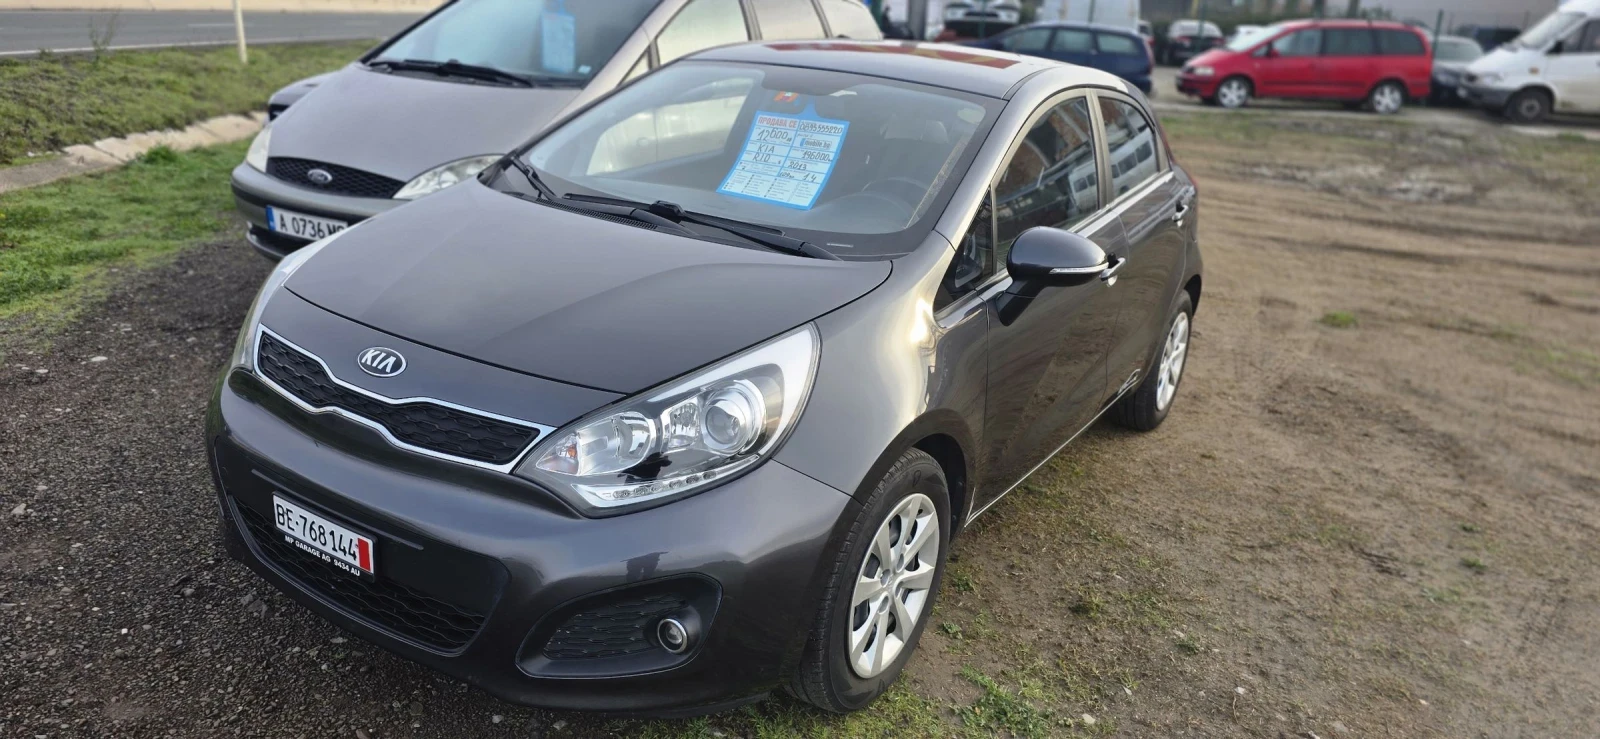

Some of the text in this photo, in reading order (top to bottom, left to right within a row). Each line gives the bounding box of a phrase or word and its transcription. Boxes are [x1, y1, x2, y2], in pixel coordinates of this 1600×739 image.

[758, 116, 798, 129] ПРОДАВА СЕ
[757, 143, 775, 153] KIA
[753, 152, 771, 162] RIO
[787, 161, 807, 171] 2013
[280, 213, 288, 232] A
[292, 216, 326, 239] 0736
[361, 349, 397, 373] KIA
[295, 540, 321, 558] GARAGE
[321, 553, 331, 563] AG
[333, 558, 350, 572] 9434
[350, 567, 361, 577] AU
